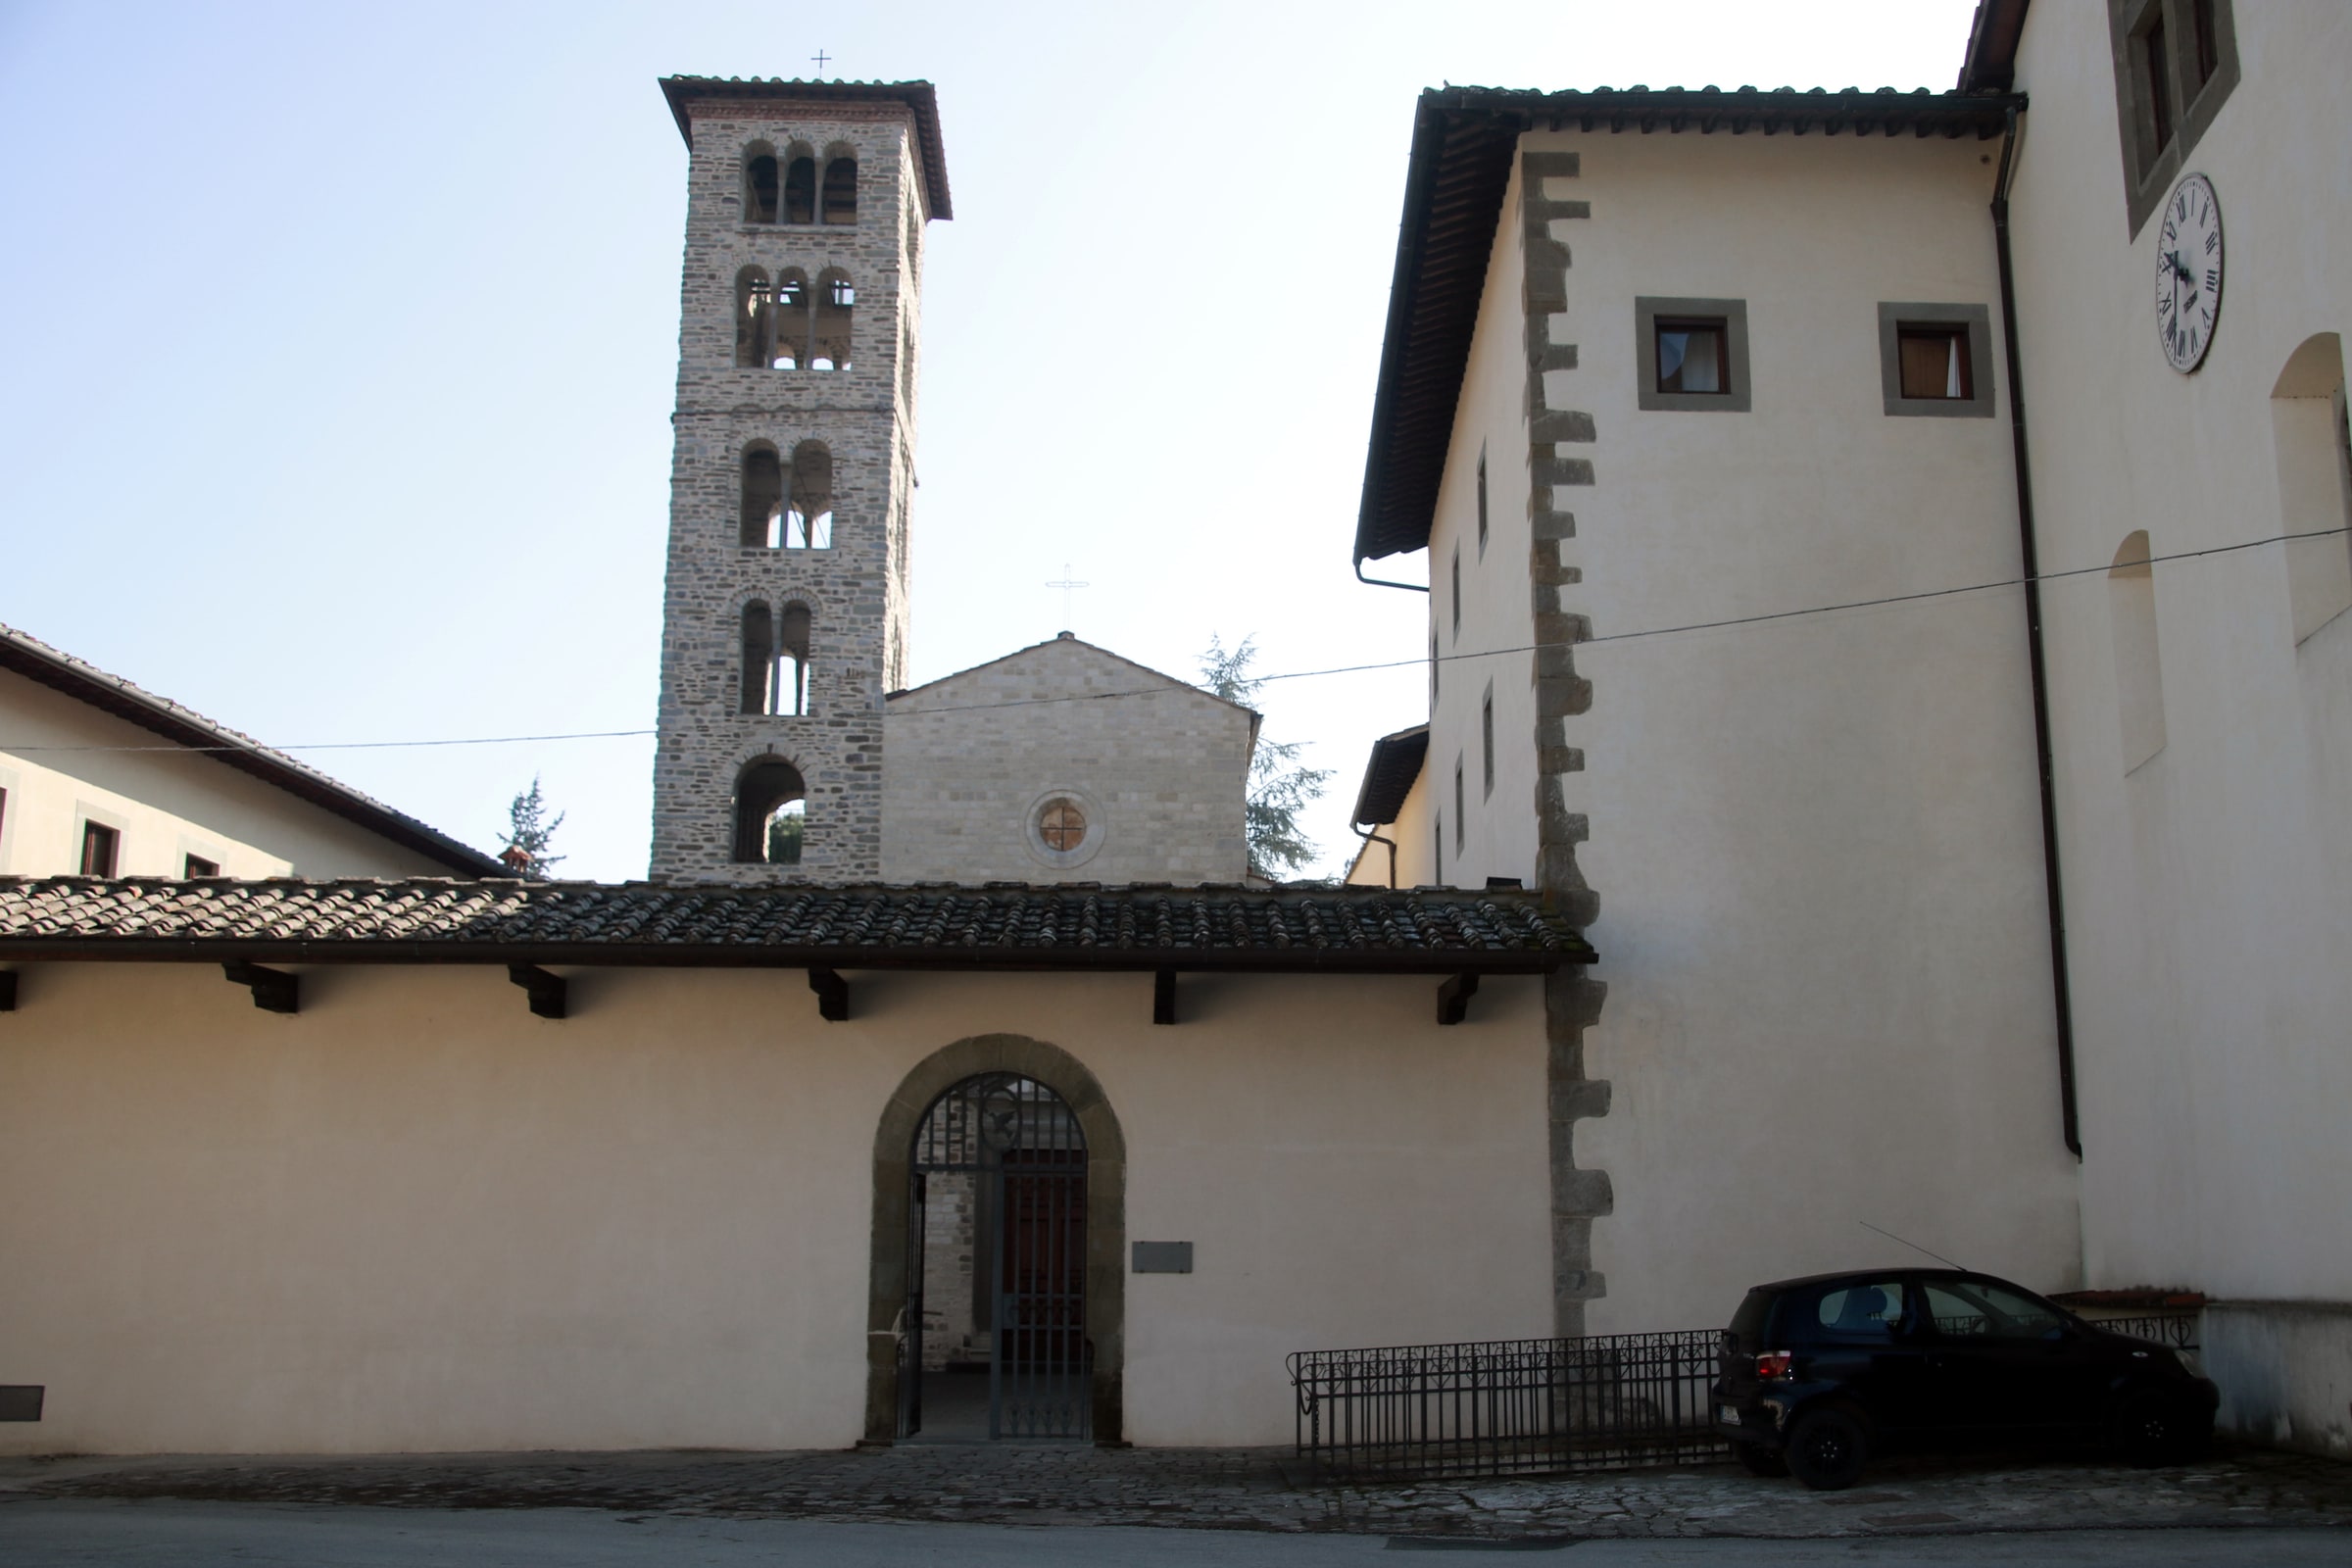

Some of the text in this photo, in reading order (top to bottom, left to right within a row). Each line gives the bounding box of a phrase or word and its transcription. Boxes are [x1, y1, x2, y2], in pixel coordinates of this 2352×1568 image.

[2199, 201, 2208, 228] II
[2205, 231, 2217, 256] III
[2161, 259, 2173, 275] X
[2205, 269, 2219, 293] IIII
[2201, 307, 2212, 329] V
